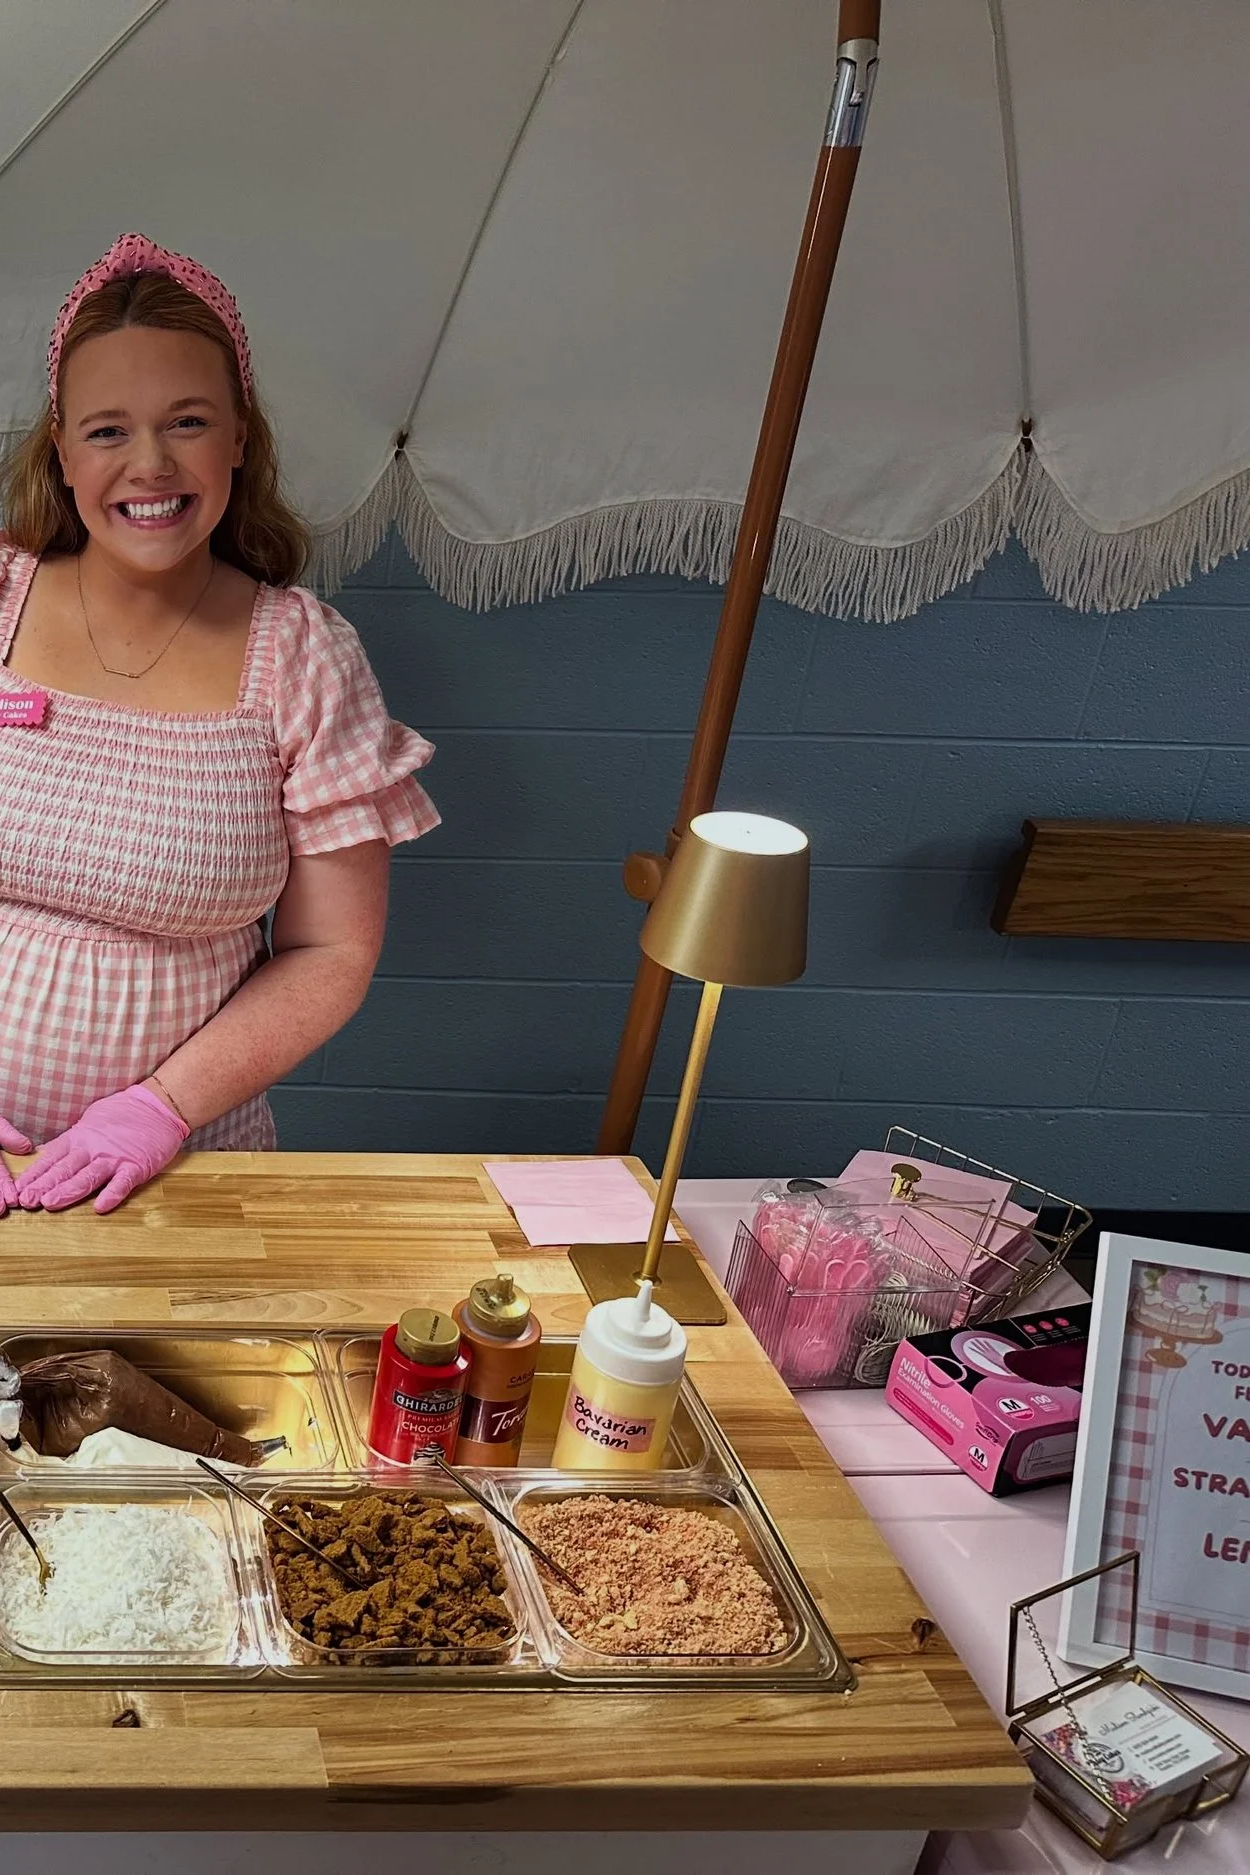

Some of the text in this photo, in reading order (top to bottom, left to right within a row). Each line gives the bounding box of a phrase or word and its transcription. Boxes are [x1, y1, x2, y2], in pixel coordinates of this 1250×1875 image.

[900, 1357, 931, 1389] Nitrile
[897, 1366, 941, 1409] Examination
[940, 1404, 965, 1430] Gloves
[1001, 1399, 1021, 1411] M
[1030, 1394, 1052, 1405] 100
[574, 1395, 647, 1436] Bavarian
[576, 1418, 629, 1450] Cream
[973, 1447, 985, 1463] M
